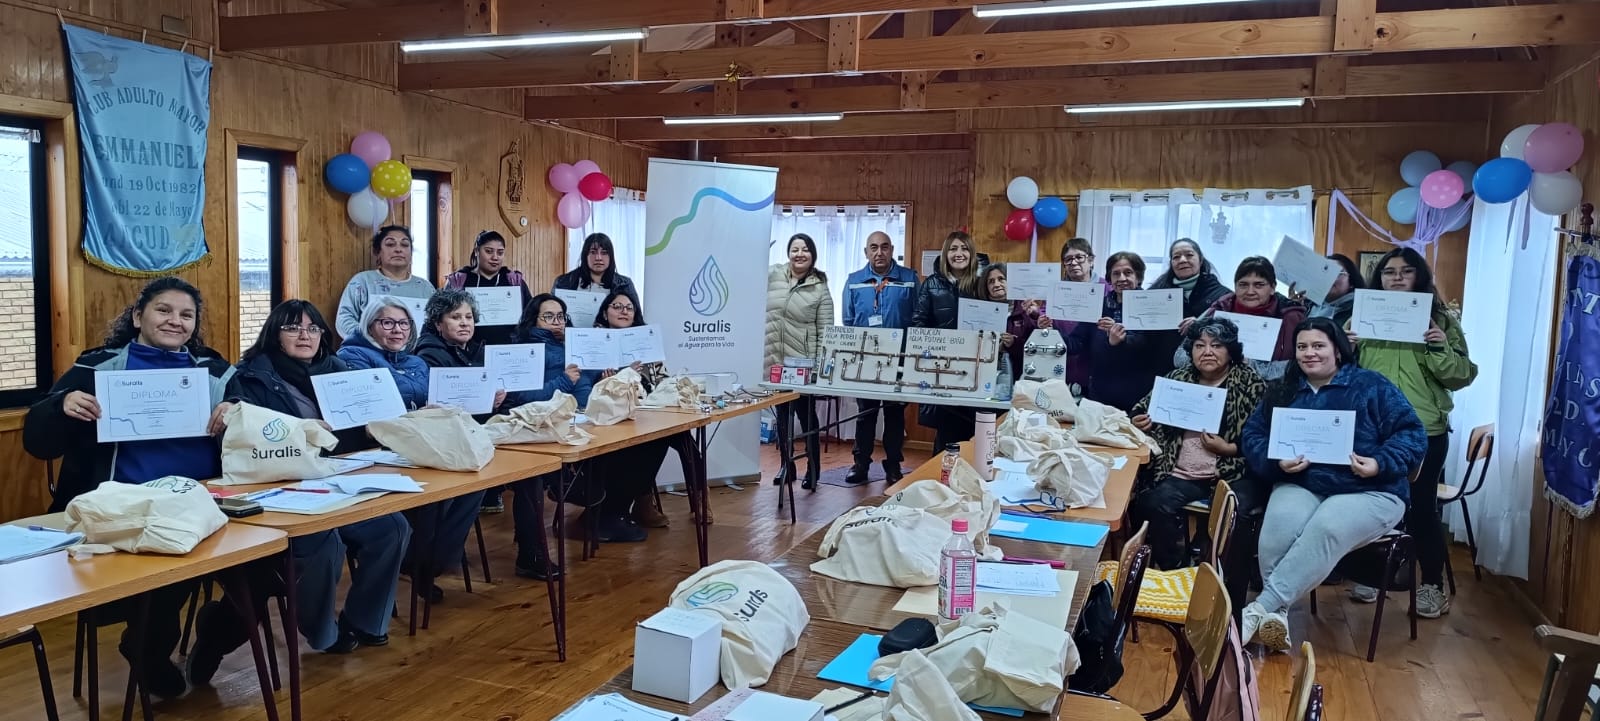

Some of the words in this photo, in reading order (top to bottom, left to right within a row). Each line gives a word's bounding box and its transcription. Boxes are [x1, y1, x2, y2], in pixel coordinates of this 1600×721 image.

[90, 91, 113, 114] LUB
[117, 86, 164, 108] ADULTO
[169, 98, 206, 132] MAYOR
[95, 134, 199, 169] EMMANUEL
[101, 174, 123, 190] und
[128, 179, 144, 191] 19
[146, 175, 168, 193] Oct
[169, 182, 197, 194] 1982
[133, 204, 150, 216] 22
[155, 201, 167, 216] de
[103, 222, 170, 250] ACUD
[683, 319, 731, 333] Suralis
[131, 390, 177, 400] DIPLOMA
[251, 445, 302, 460] Suralis
